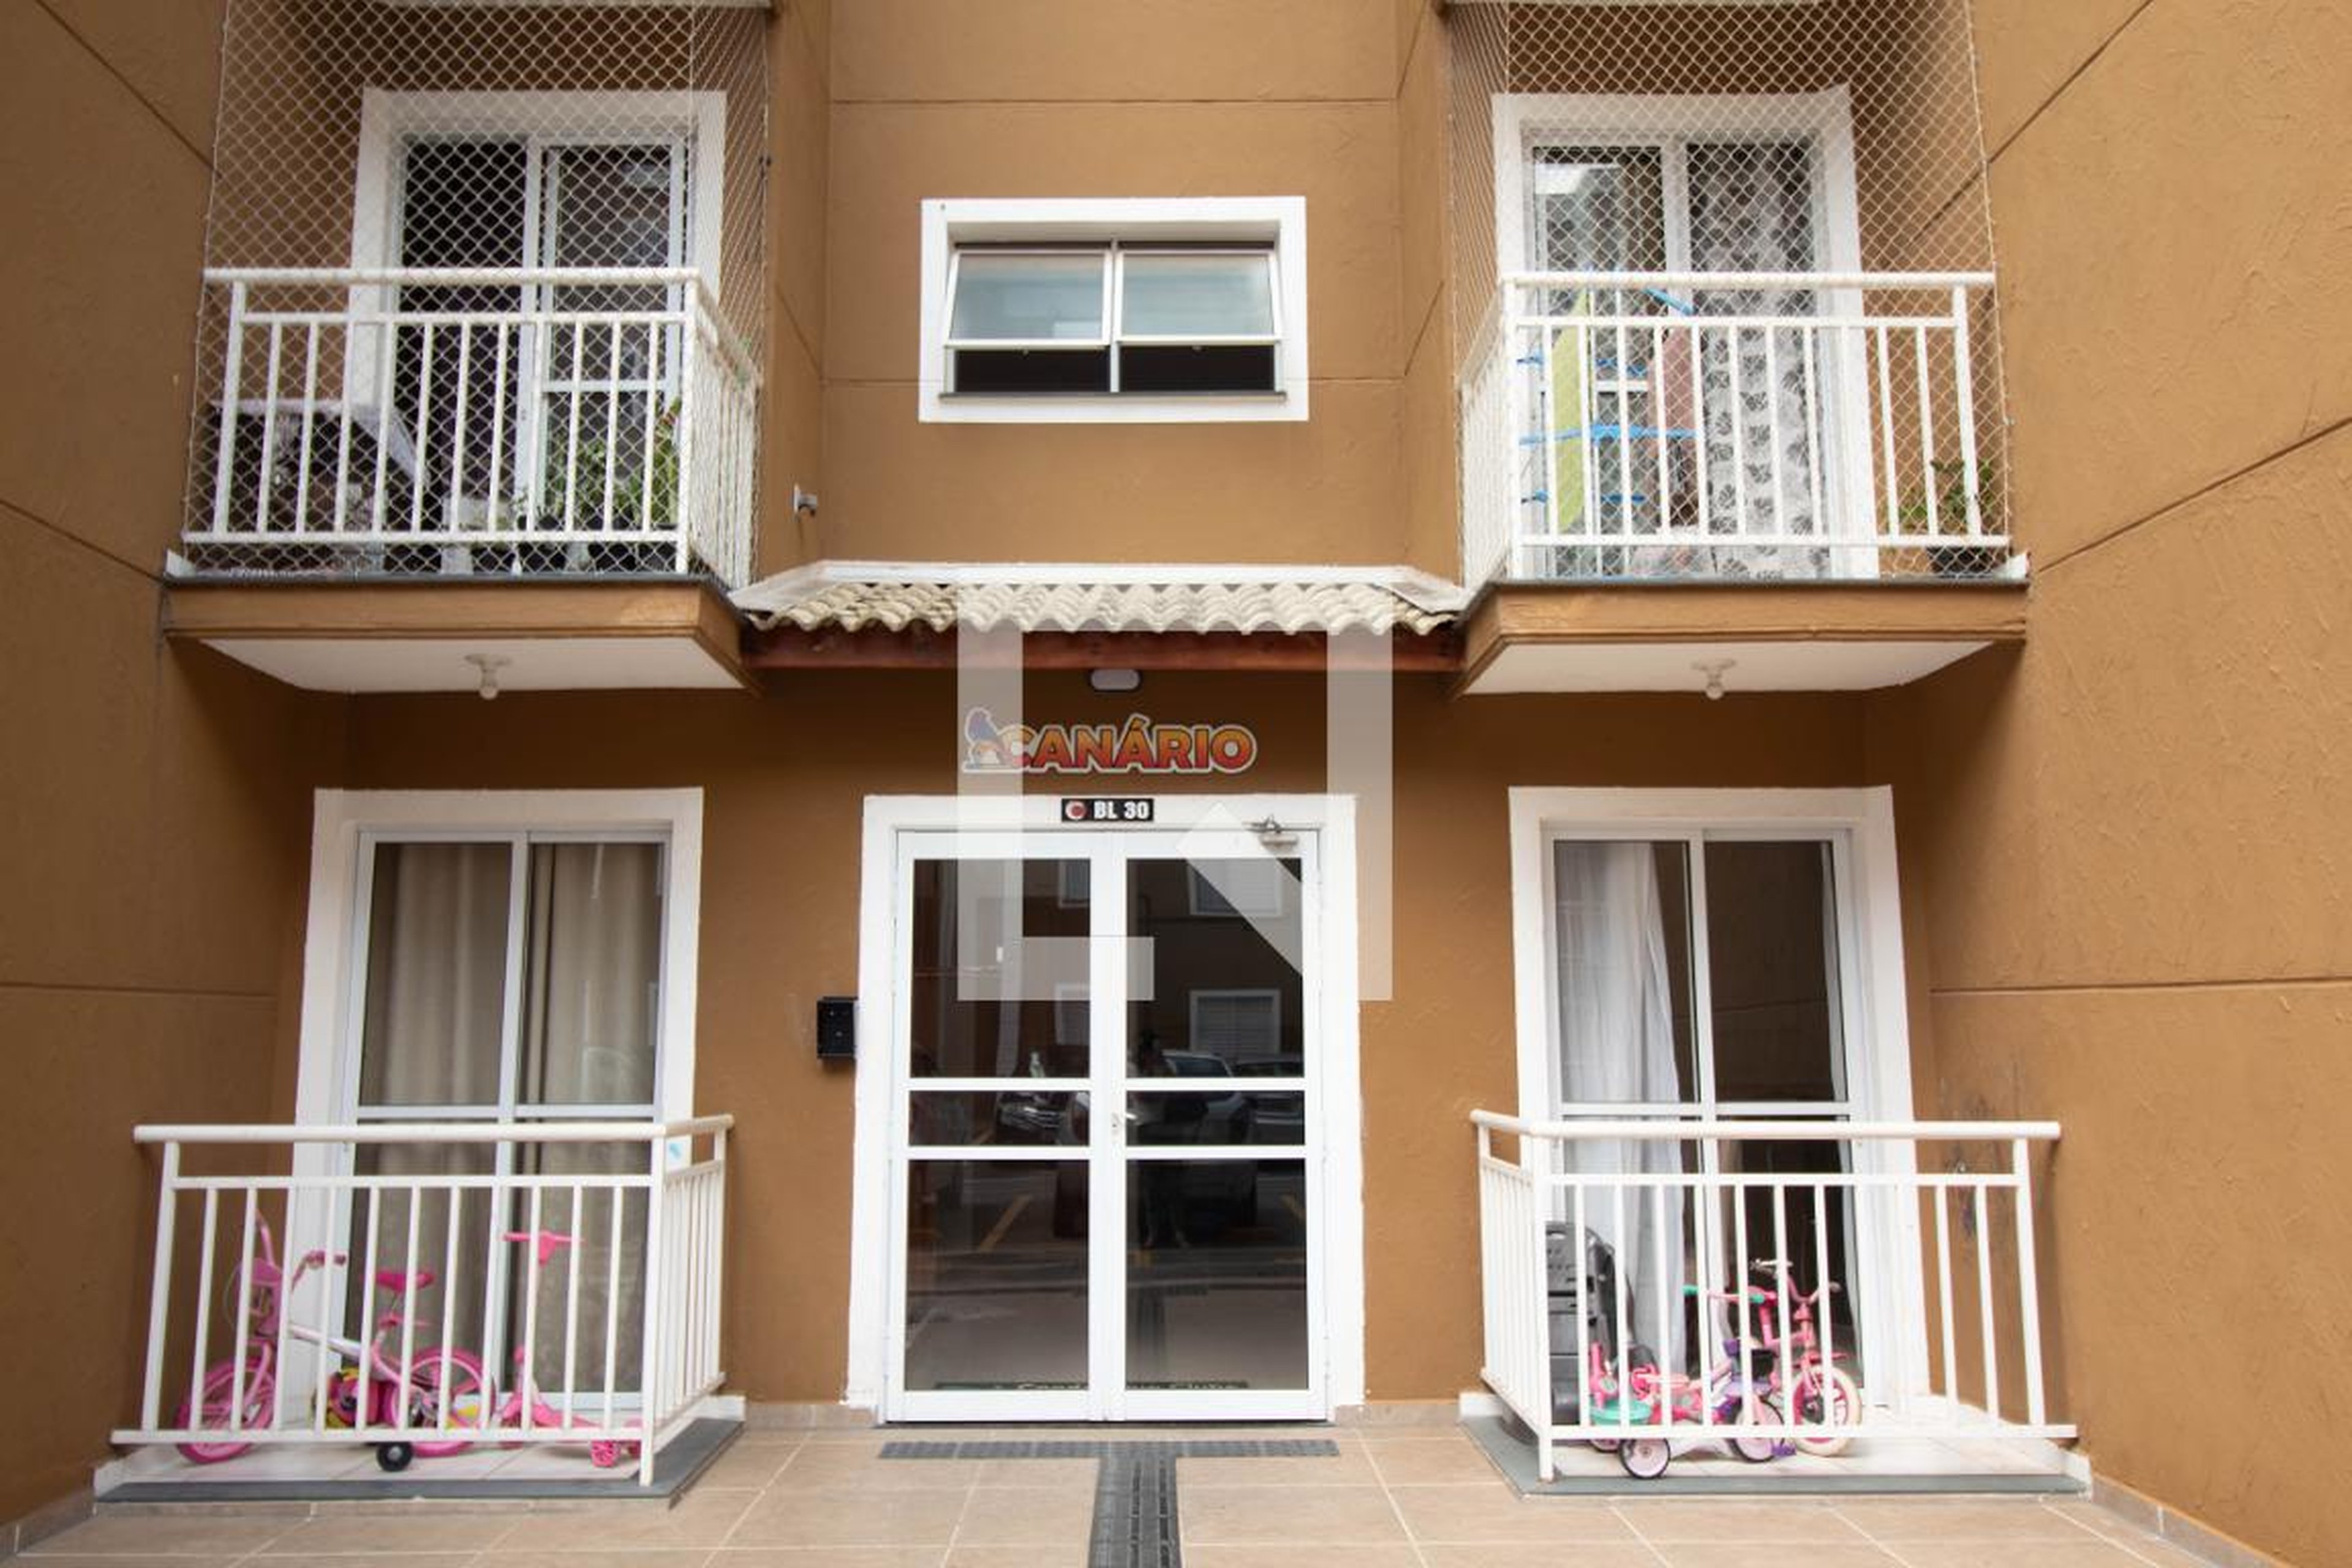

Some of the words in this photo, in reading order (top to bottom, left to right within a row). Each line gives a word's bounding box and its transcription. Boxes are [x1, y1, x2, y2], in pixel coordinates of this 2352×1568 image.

[1000, 715, 1254, 771] CANÁRIO
[1094, 801, 1118, 819] BL
[1123, 801, 1150, 820] 30
